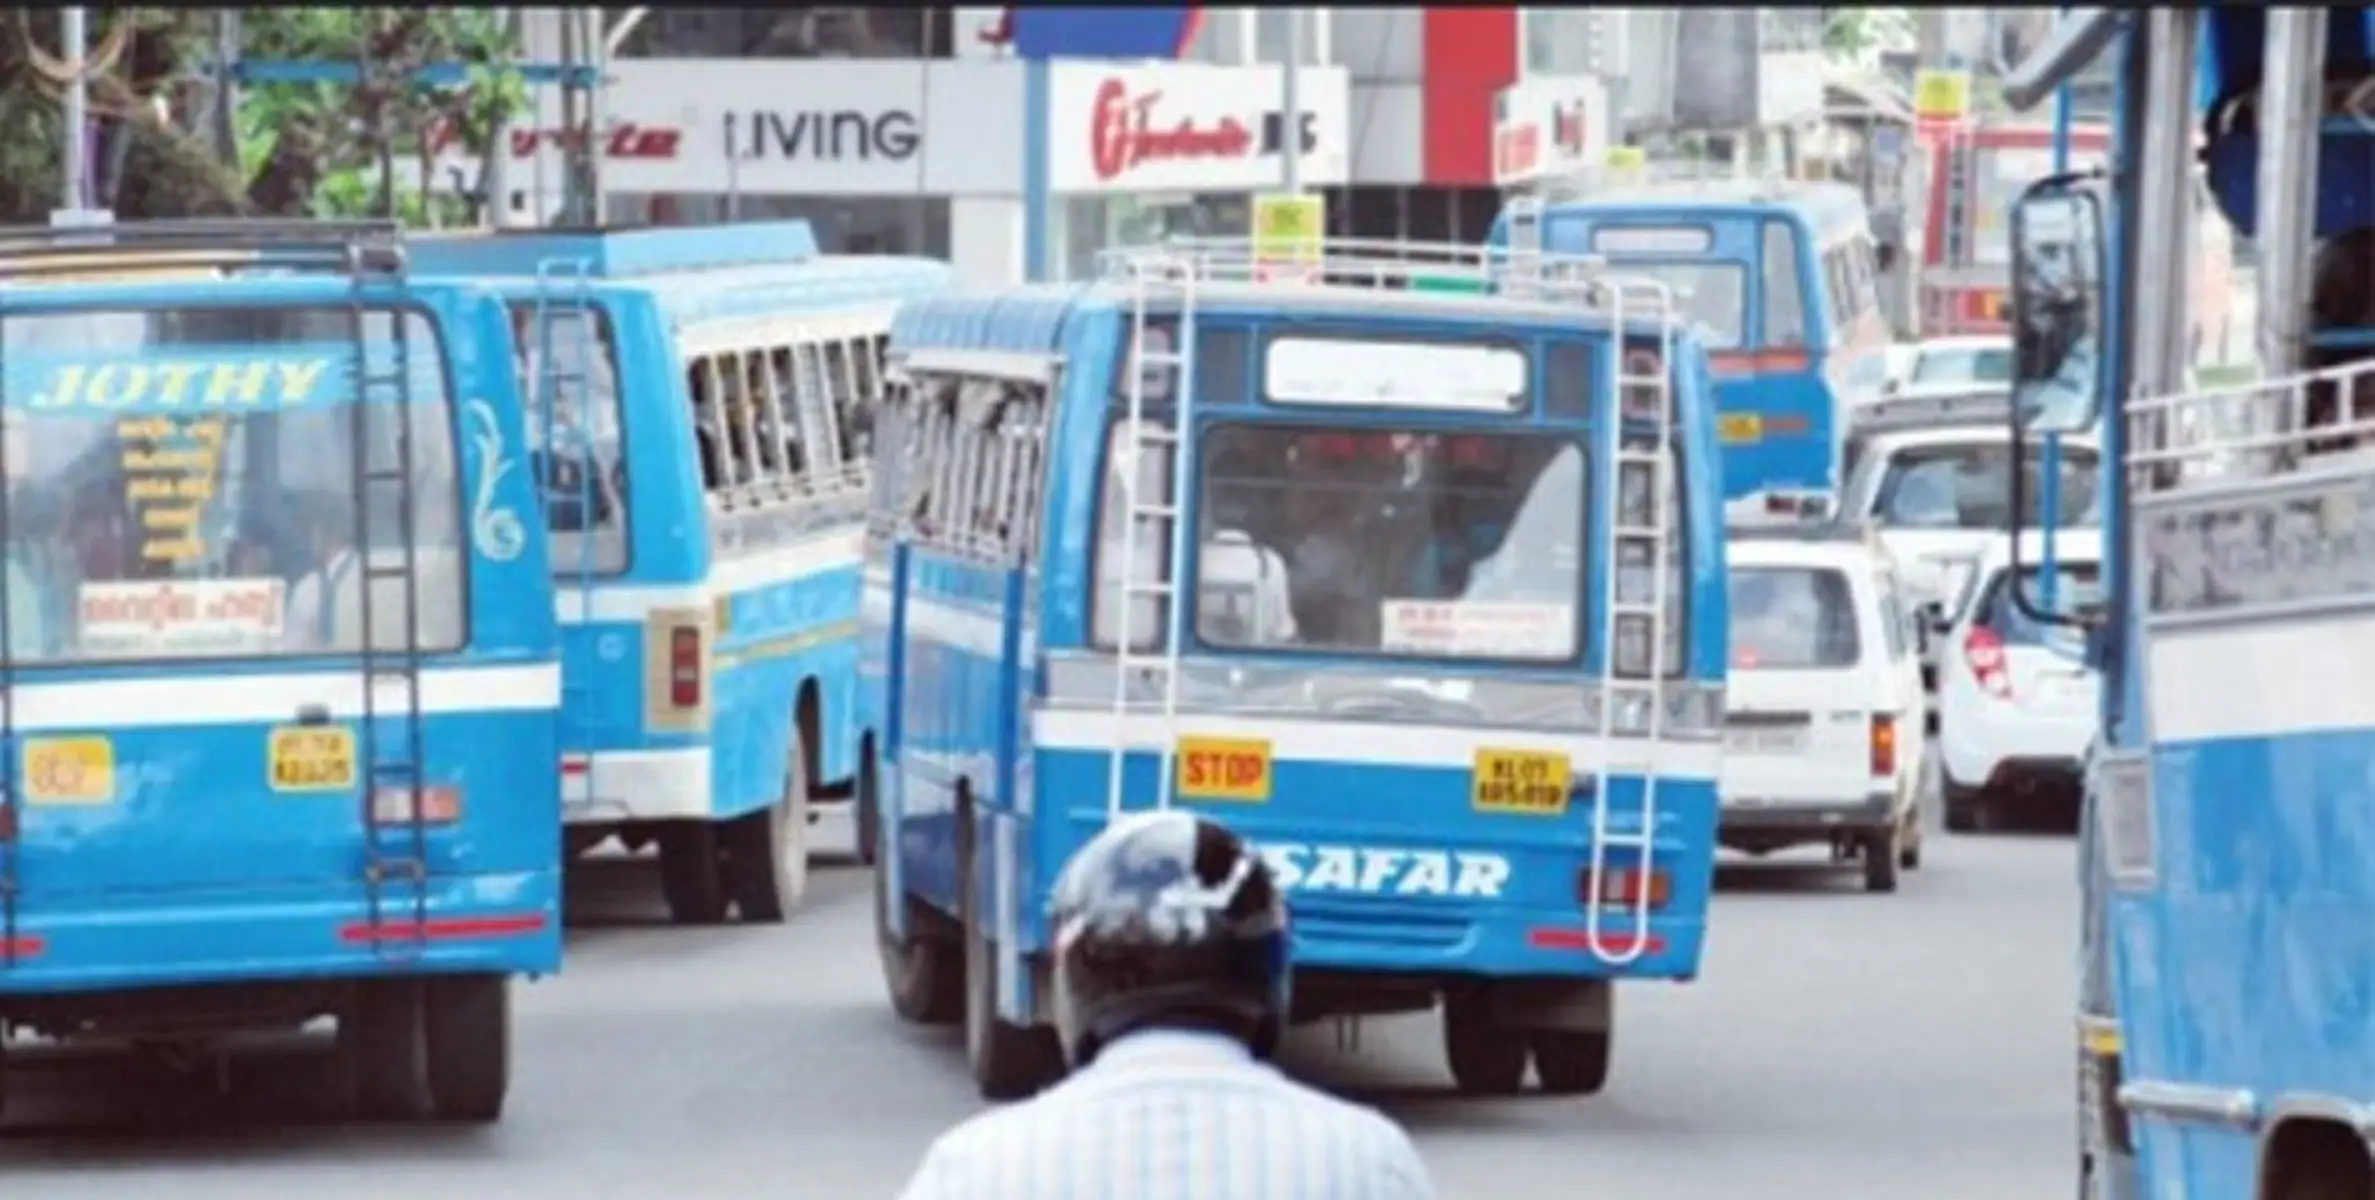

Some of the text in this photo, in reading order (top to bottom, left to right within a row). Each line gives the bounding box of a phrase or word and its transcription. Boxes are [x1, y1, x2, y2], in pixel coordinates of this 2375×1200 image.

[29, 359, 328, 406] JOTHY
[1186, 750, 1263, 788] STOP
[1258, 843, 1510, 896] SAFAR
